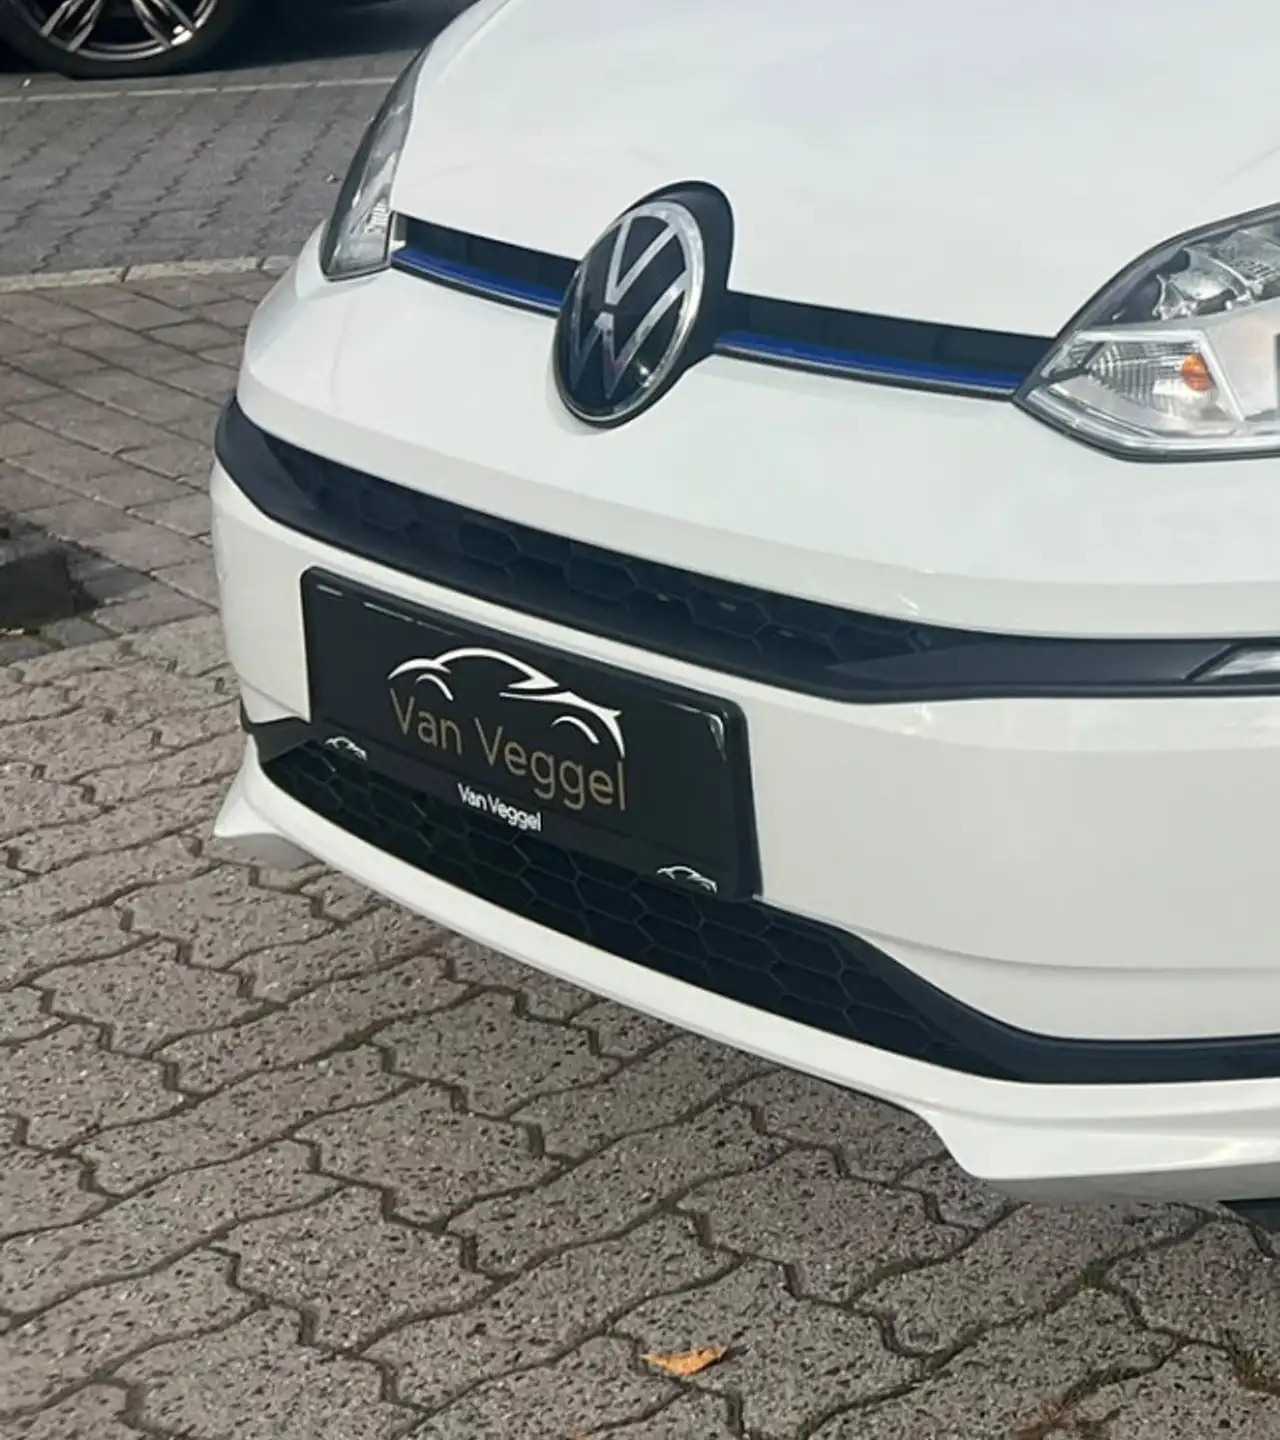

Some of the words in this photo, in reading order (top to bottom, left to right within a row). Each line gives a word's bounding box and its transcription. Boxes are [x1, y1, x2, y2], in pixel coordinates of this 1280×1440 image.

[389, 687, 463, 756] Van
[473, 716, 626, 811] Veggel
[457, 782, 488, 811] Van
[487, 793, 541, 832] Veggel
